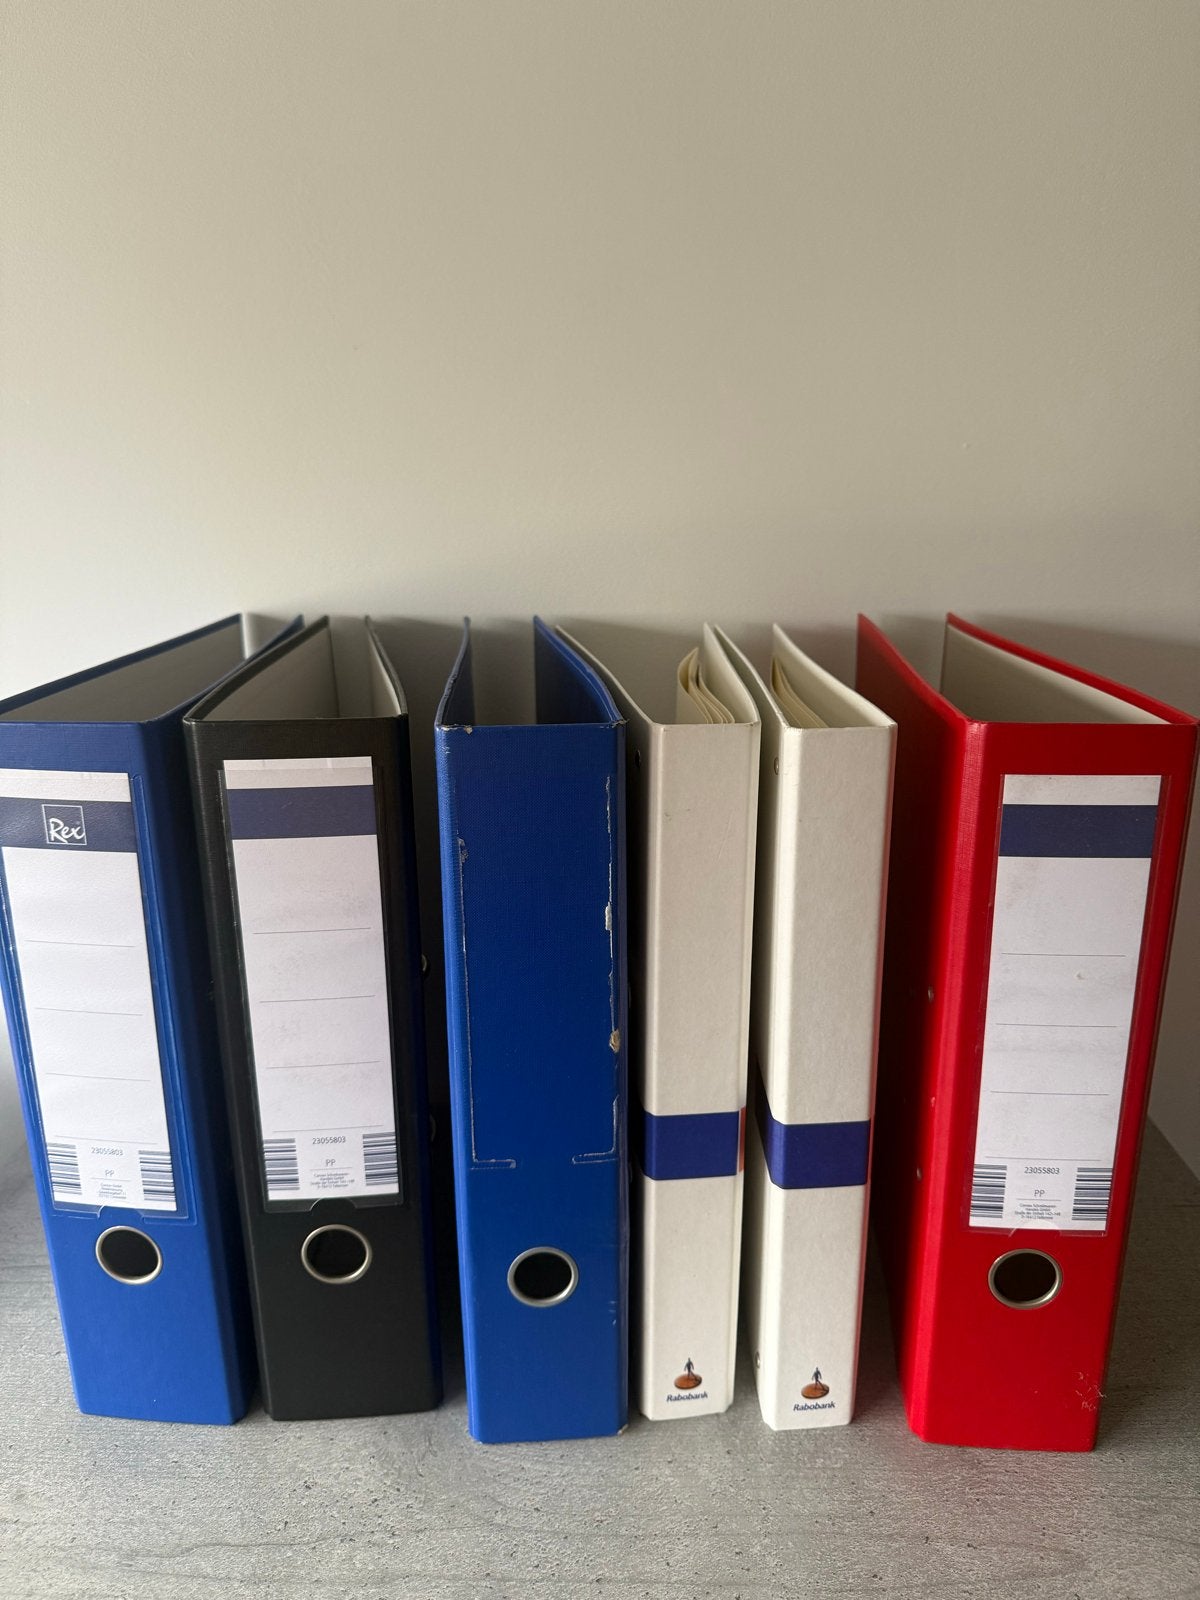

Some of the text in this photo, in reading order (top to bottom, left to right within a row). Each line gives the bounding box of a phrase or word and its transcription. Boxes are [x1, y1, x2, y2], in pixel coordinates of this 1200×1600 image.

[49, 817, 86, 844] Rex
[312, 1136, 346, 1145] 23055803
[325, 1158, 336, 1167] PP
[105, 1169, 115, 1177] PP
[1024, 1166, 1060, 1175] 23055803
[1034, 1189, 1045, 1198] PP
[666, 1391, 708, 1402] Rabobank
[793, 1401, 836, 1411] Rabobank
